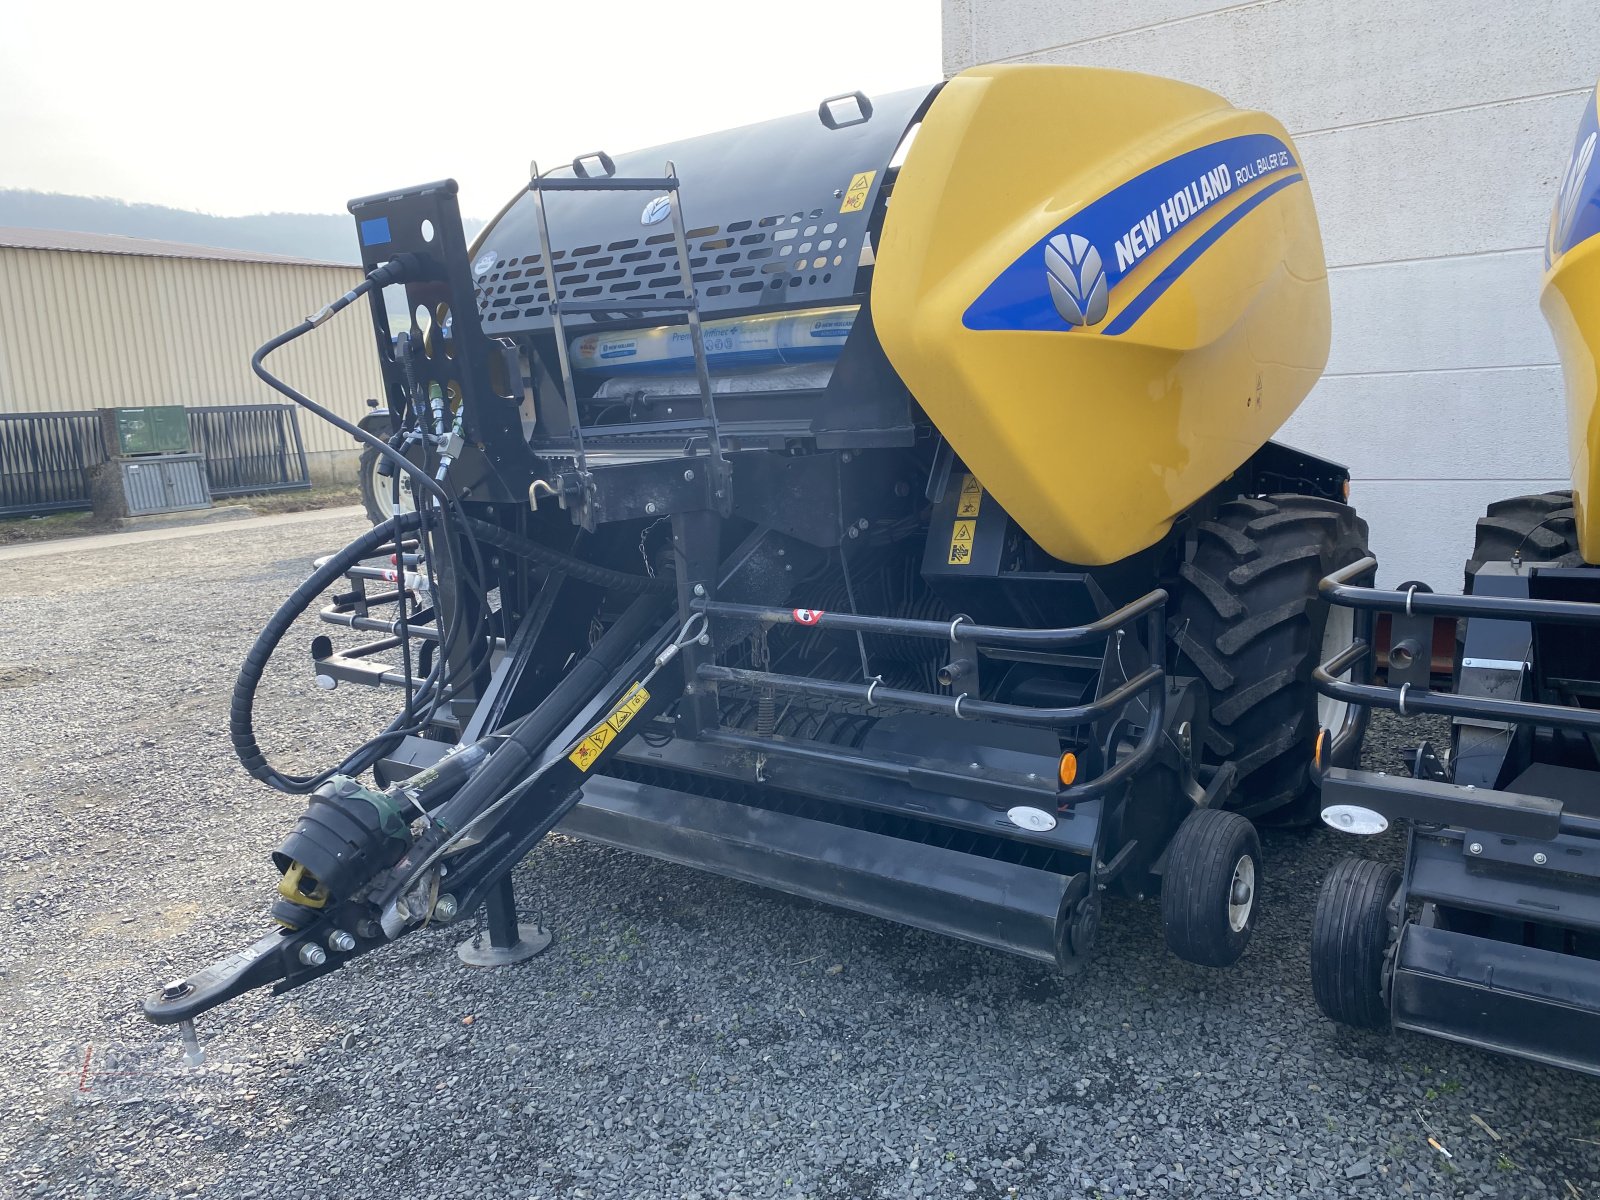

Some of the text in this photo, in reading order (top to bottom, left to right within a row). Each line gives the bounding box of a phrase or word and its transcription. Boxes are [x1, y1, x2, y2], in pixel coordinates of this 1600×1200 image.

[1235, 150, 1289, 186] ROLL BALER 125
[1114, 163, 1232, 273] NEW HOLLAND
